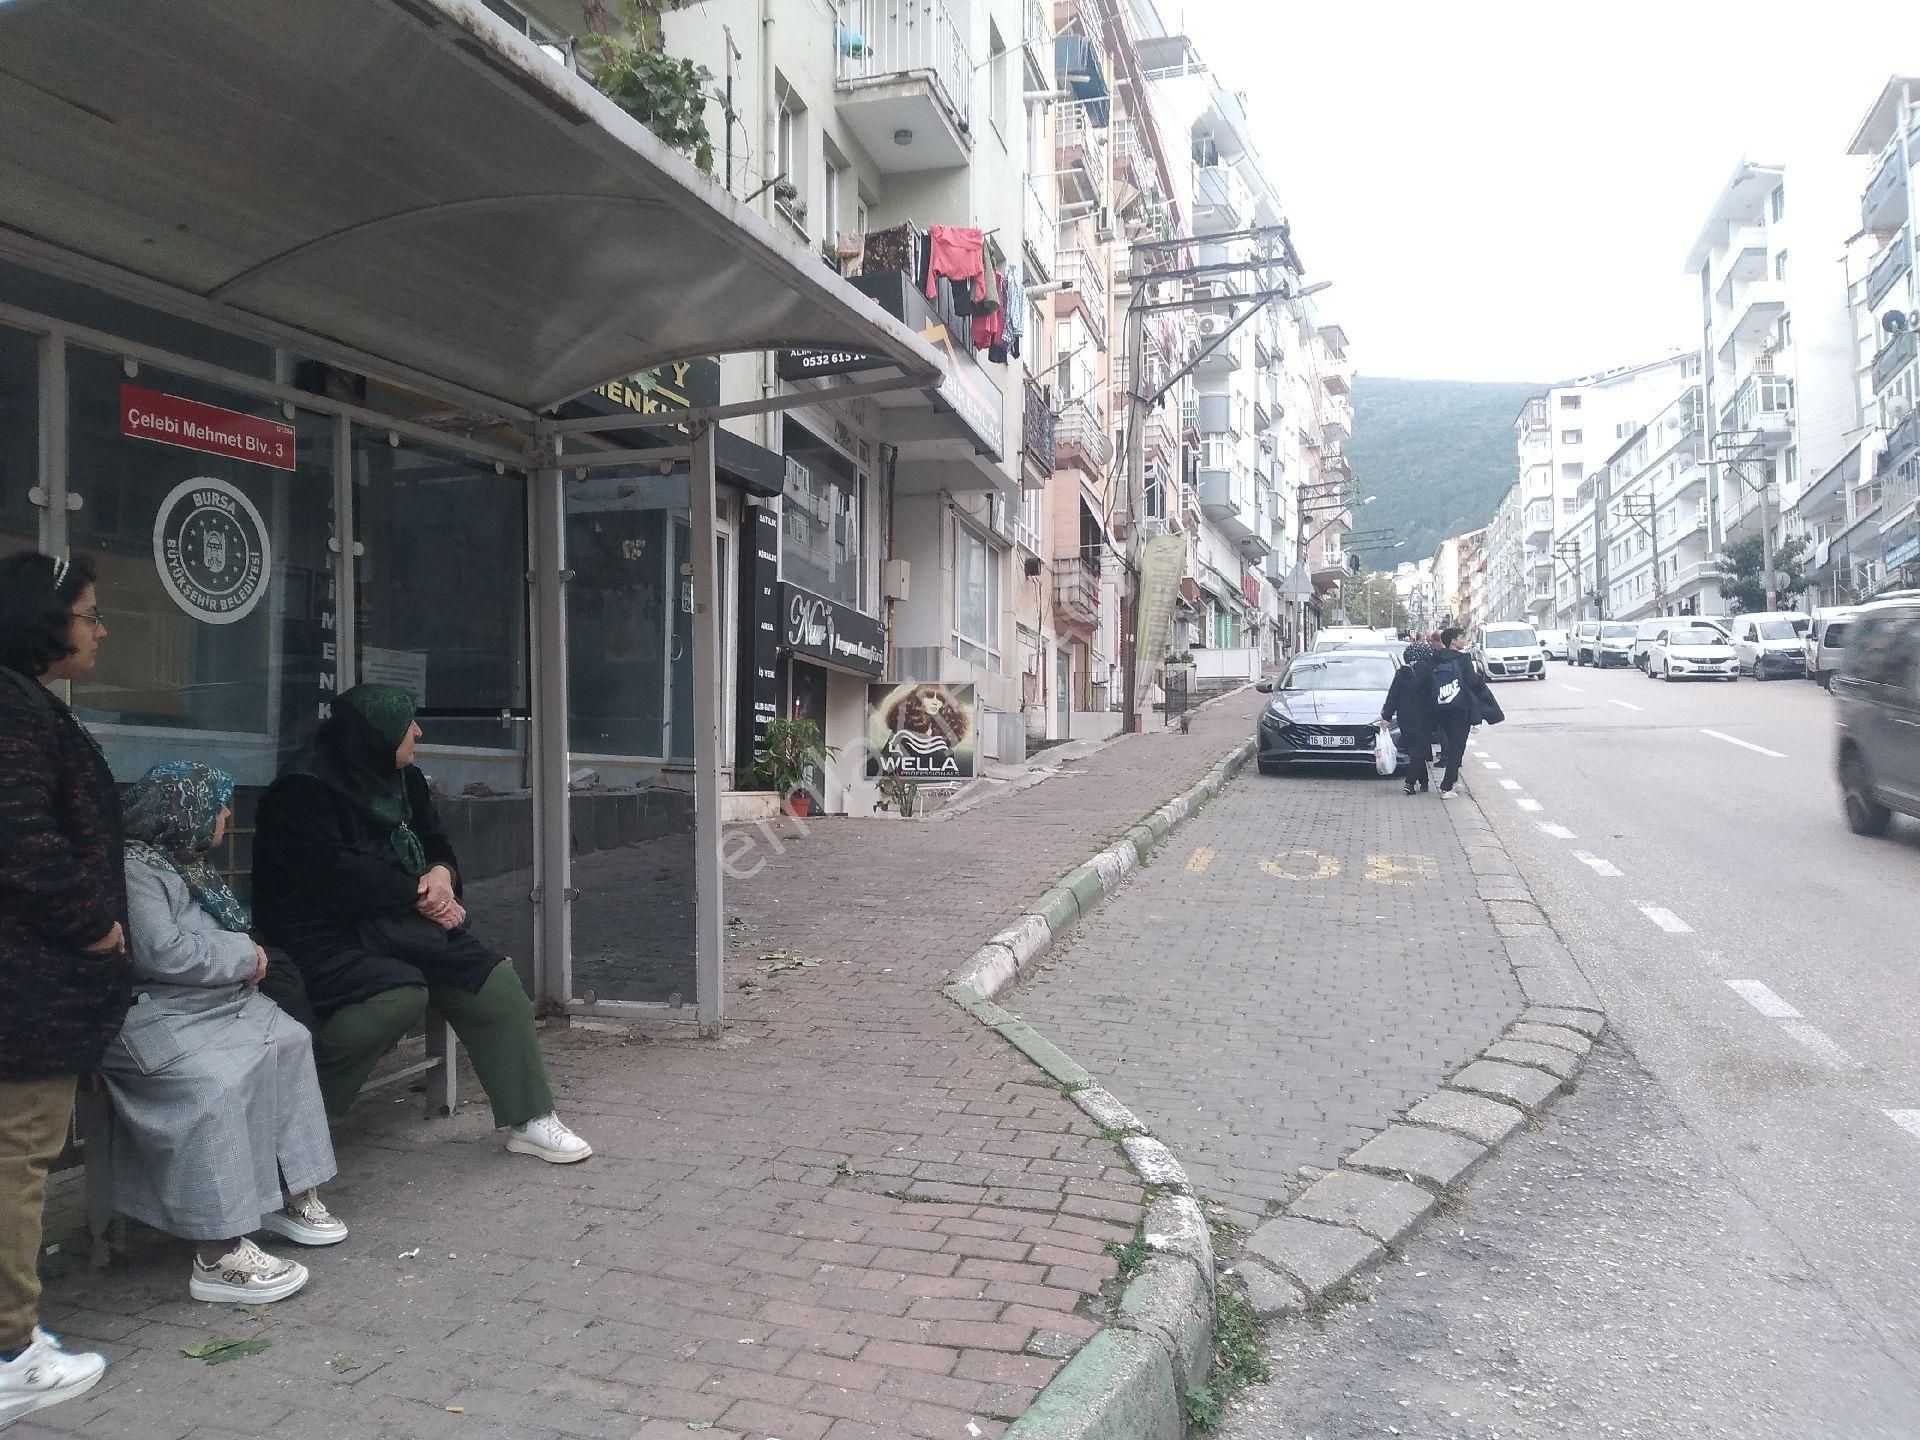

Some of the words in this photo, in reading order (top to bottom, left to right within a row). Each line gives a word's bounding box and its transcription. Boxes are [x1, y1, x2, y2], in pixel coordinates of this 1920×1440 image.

[803, 355, 830, 367] 0532
[832, 352, 852, 364] 615
[128, 408, 179, 434] Çelebi
[183, 420, 243, 449] Mehmet
[245, 435, 271, 455] Blv.
[275, 443, 284, 458] 3
[192, 491, 237, 516] BURSA
[759, 514, 777, 528] SATILIK
[763, 587, 771, 596] EV
[760, 621, 774, 632] ARSA
[1440, 678, 1459, 700] NIKE
[1311, 736, 1319, 745] 16
[1340, 736, 1354, 745] 960
[880, 756, 959, 772] WELLA
